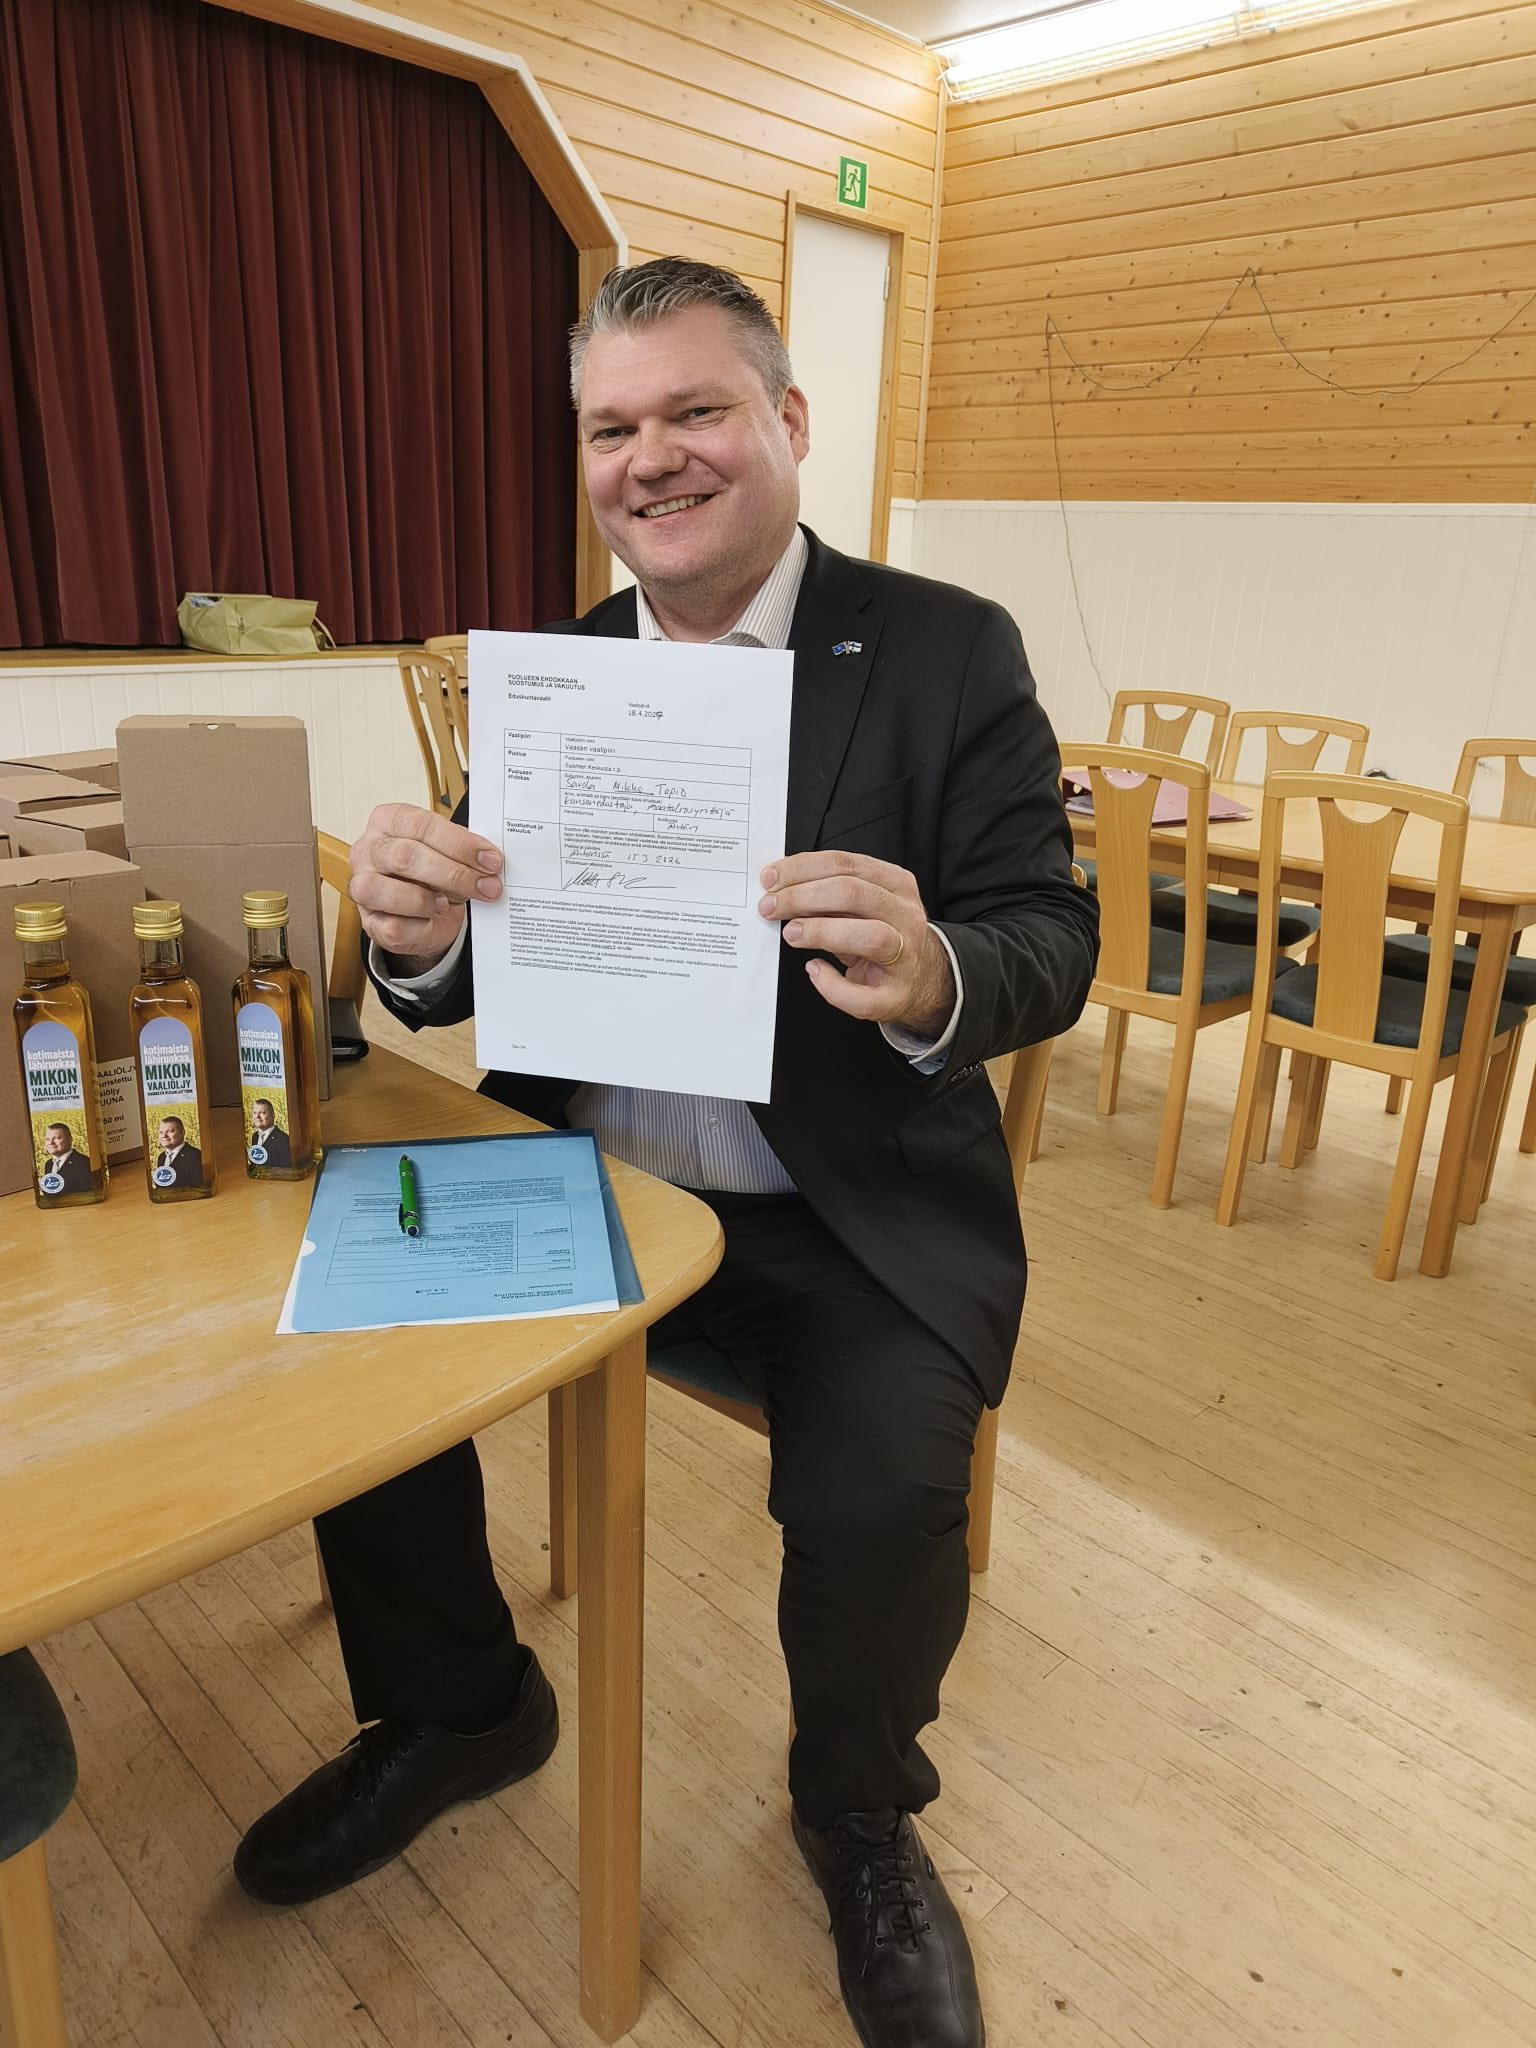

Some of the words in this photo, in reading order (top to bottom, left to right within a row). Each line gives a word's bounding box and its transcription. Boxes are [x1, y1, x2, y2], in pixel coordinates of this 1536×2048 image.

[508, 680, 544, 688] SUOSTUMUS
[554, 683, 586, 691] VAKUUTUS
[540, 675, 578, 684] EHDOKKAAN
[508, 692, 552, 701] Eduskuntavaalit
[590, 746, 616, 754] vaalipiiri
[654, 783, 687, 798] Tapio
[507, 821, 536, 829] Suostumus
[240, 1028, 279, 1040] kotimaista
[240, 1037, 279, 1049] lähiruokaa
[27, 1049, 75, 1061] kotimaista
[144, 1044, 189, 1056] kotimaista
[241, 1047, 280, 1064] MIKON
[28, 1058, 76, 1070] lähiruokaa
[145, 1053, 190, 1065] lähiruokaa
[97, 1064, 137, 1078] AALIÖLJY
[145, 1063, 191, 1080] MIKON
[242, 1062, 280, 1074] VAALIÖLJY
[29, 1068, 78, 1086] MIKON
[98, 1075, 133, 1088] uristettu
[32, 1084, 77, 1097] VAALIÖLJY
[147, 1079, 191, 1091] VAALIÖLJY
[99, 1087, 120, 1098] siöljy
[100, 1095, 125, 1107] UUNA
[114, 1113, 125, 1122] ml
